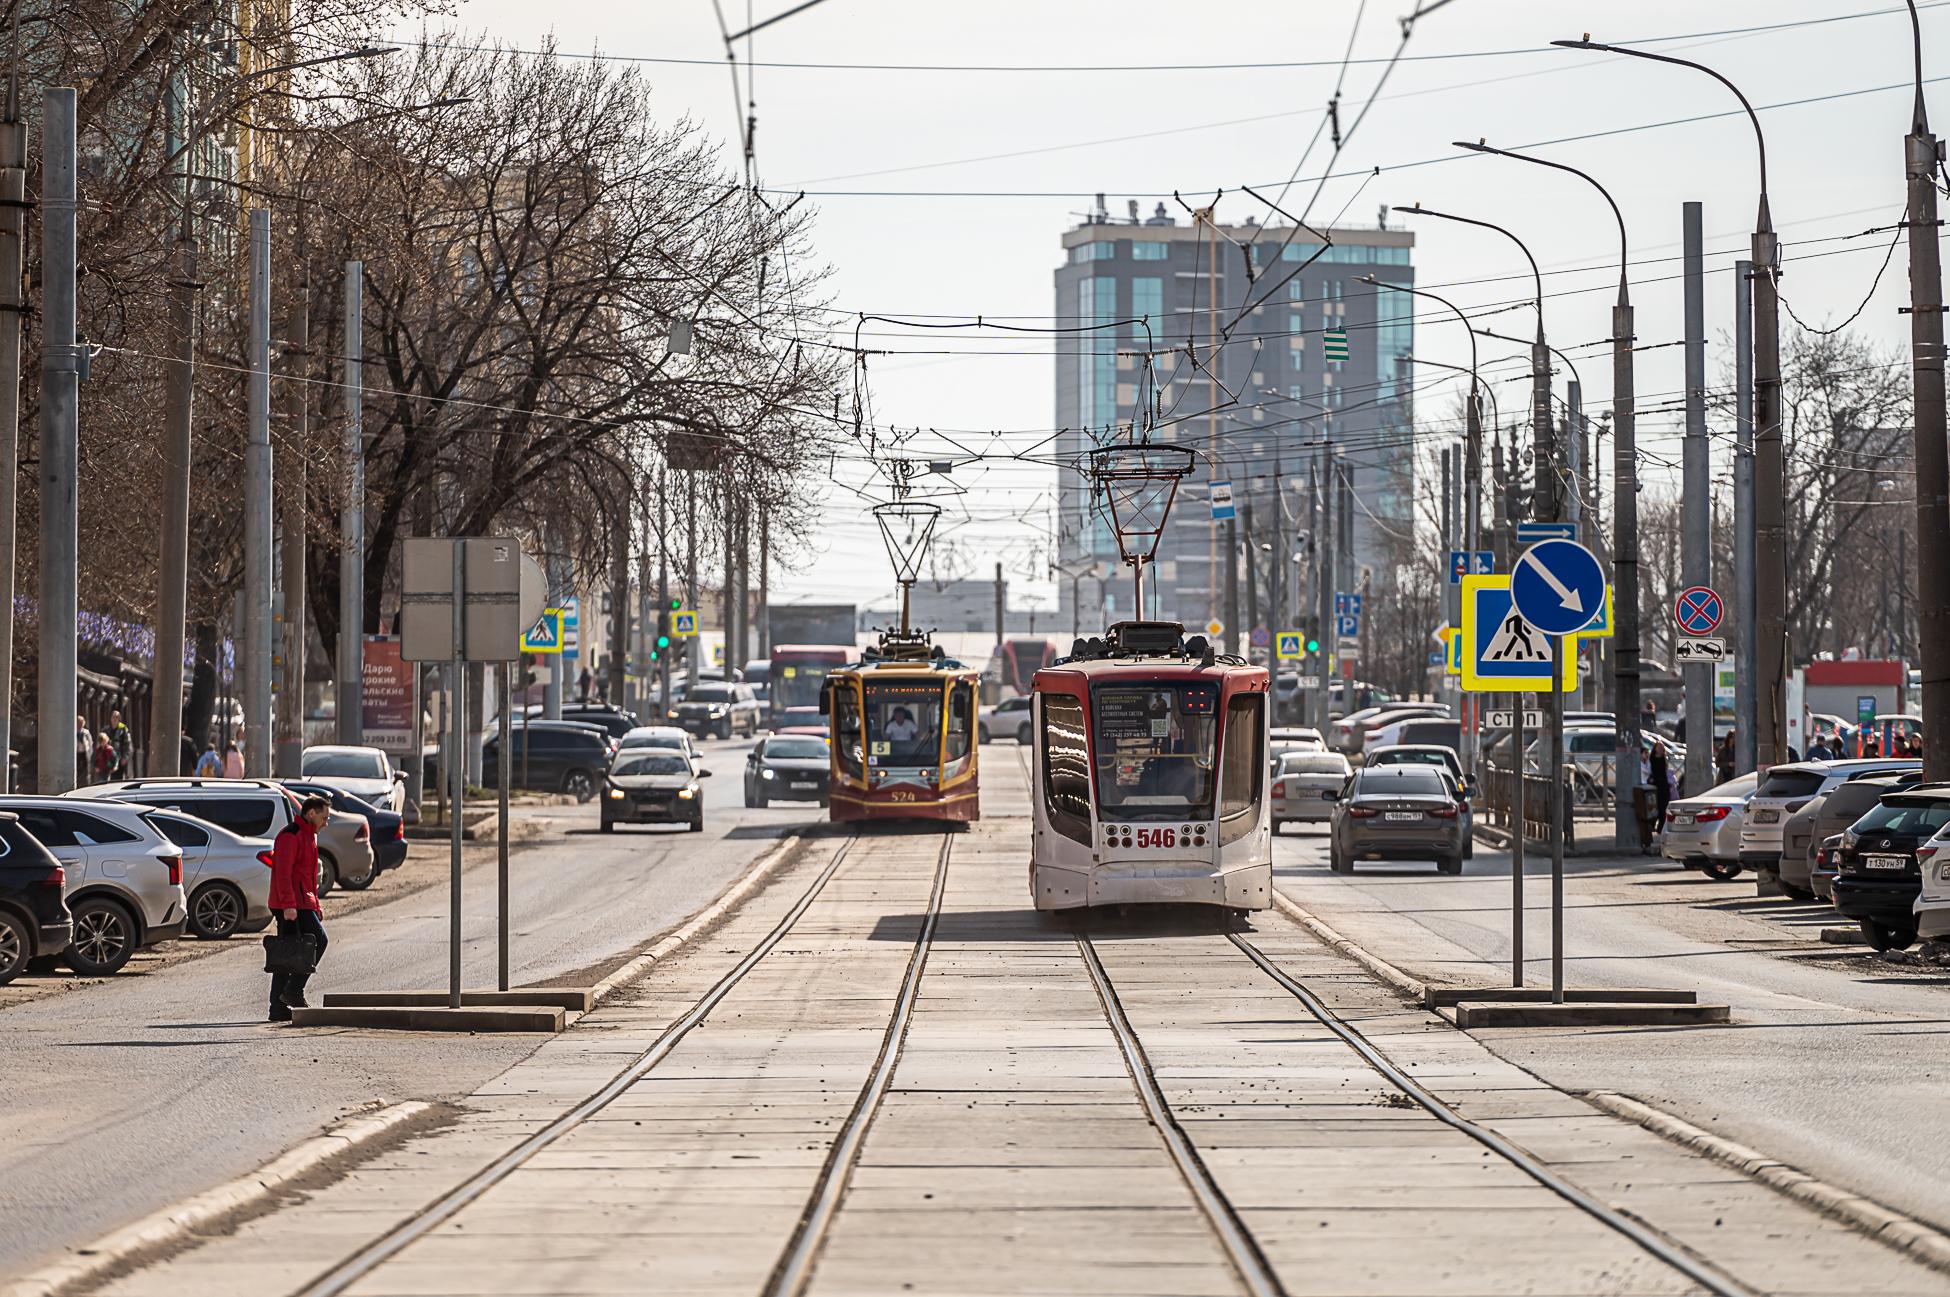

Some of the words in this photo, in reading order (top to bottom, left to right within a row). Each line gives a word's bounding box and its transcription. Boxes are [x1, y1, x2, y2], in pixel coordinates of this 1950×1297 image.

[363, 664, 392, 675] Дарю
[362, 676, 397, 684] рокие
[362, 687, 404, 696] альские
[1492, 713, 1536, 726] СТП
[877, 743, 884, 752] 5
[891, 792, 915, 802] 524
[1137, 828, 1175, 848] 546
